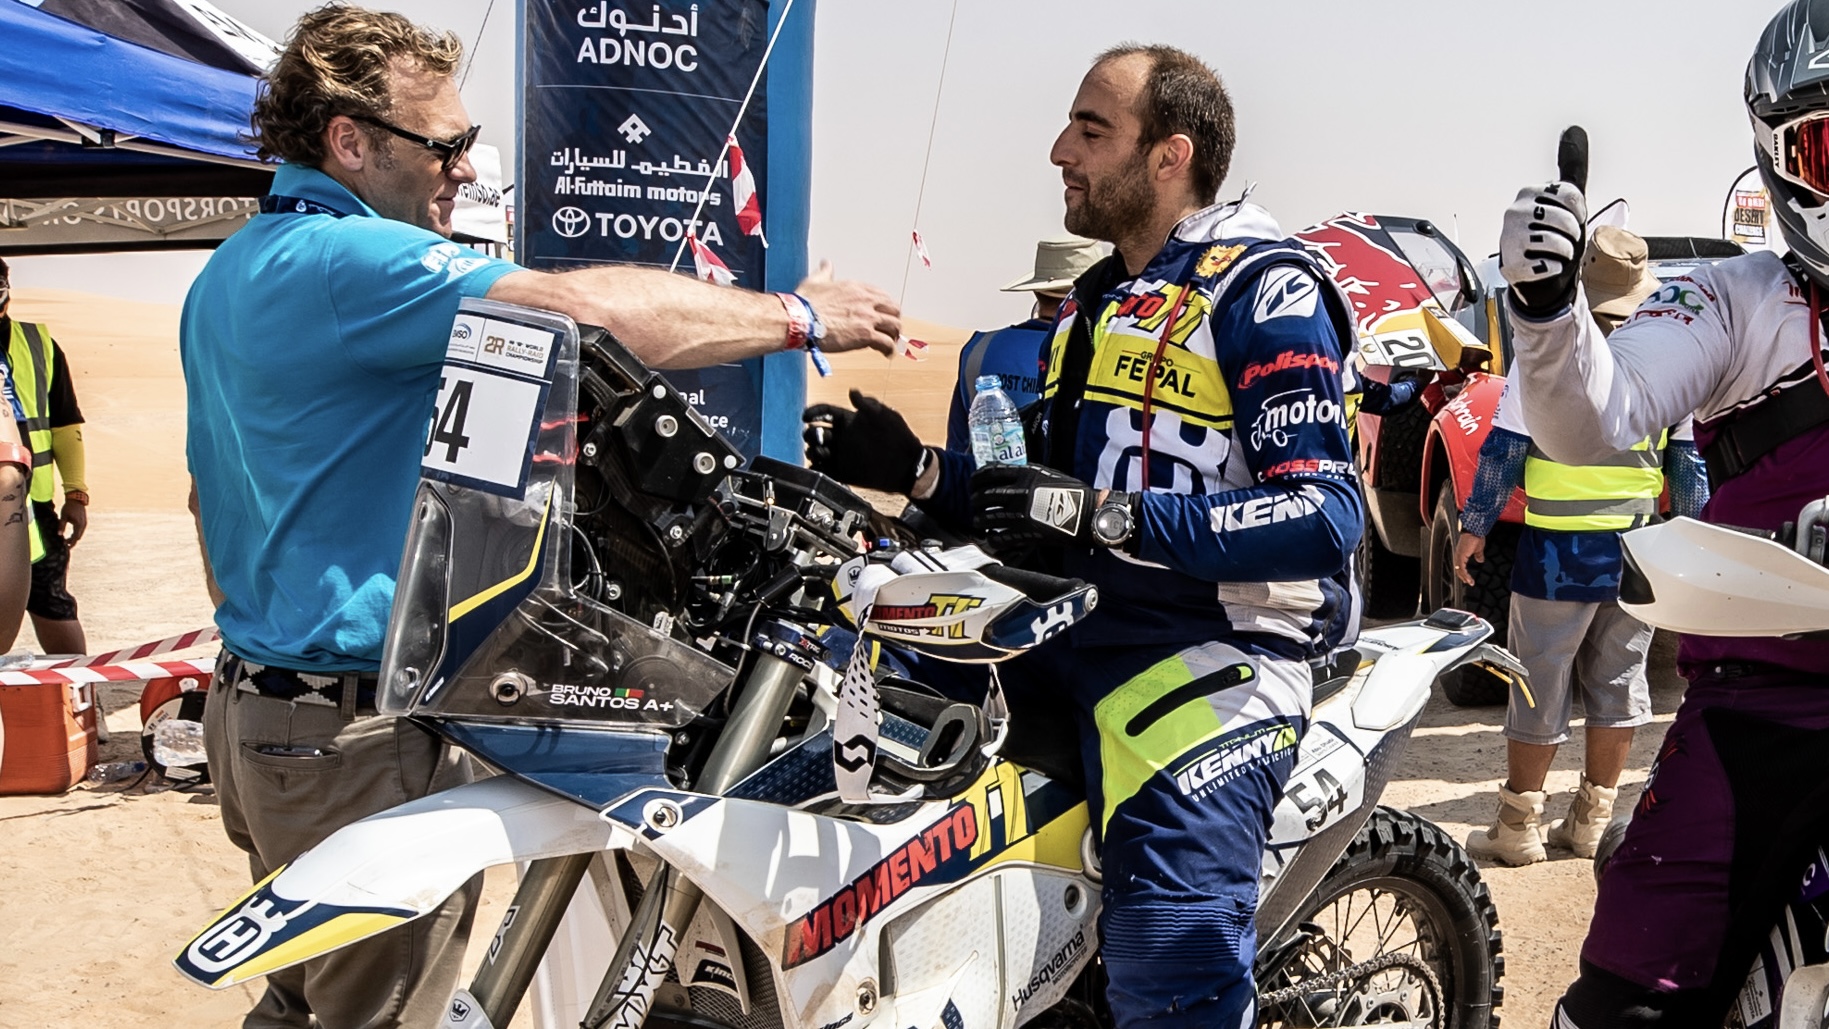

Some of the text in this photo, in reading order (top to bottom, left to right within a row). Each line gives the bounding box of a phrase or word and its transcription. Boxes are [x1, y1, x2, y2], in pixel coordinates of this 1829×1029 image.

[577, 37, 698, 72] ADNOC
[554, 176, 642, 199] Al-Futtaim
[595, 212, 724, 247] TOYOTA
[1140, 350, 1175, 367] GRPO
[1381, 336, 1437, 368] 20
[1113, 355, 1197, 399] FEPAL
[869, 604, 937, 621] OMENTO
[549, 694, 674, 711] SANTOS A+
[551, 683, 611, 696] BRUNO
[1176, 731, 1278, 796] KENNY
[1191, 767, 1247, 802] UNLIMITED
[1284, 767, 1348, 832] 54
[782, 802, 979, 971] MOMENTO
[1011, 929, 1085, 1012] Husqvarna
